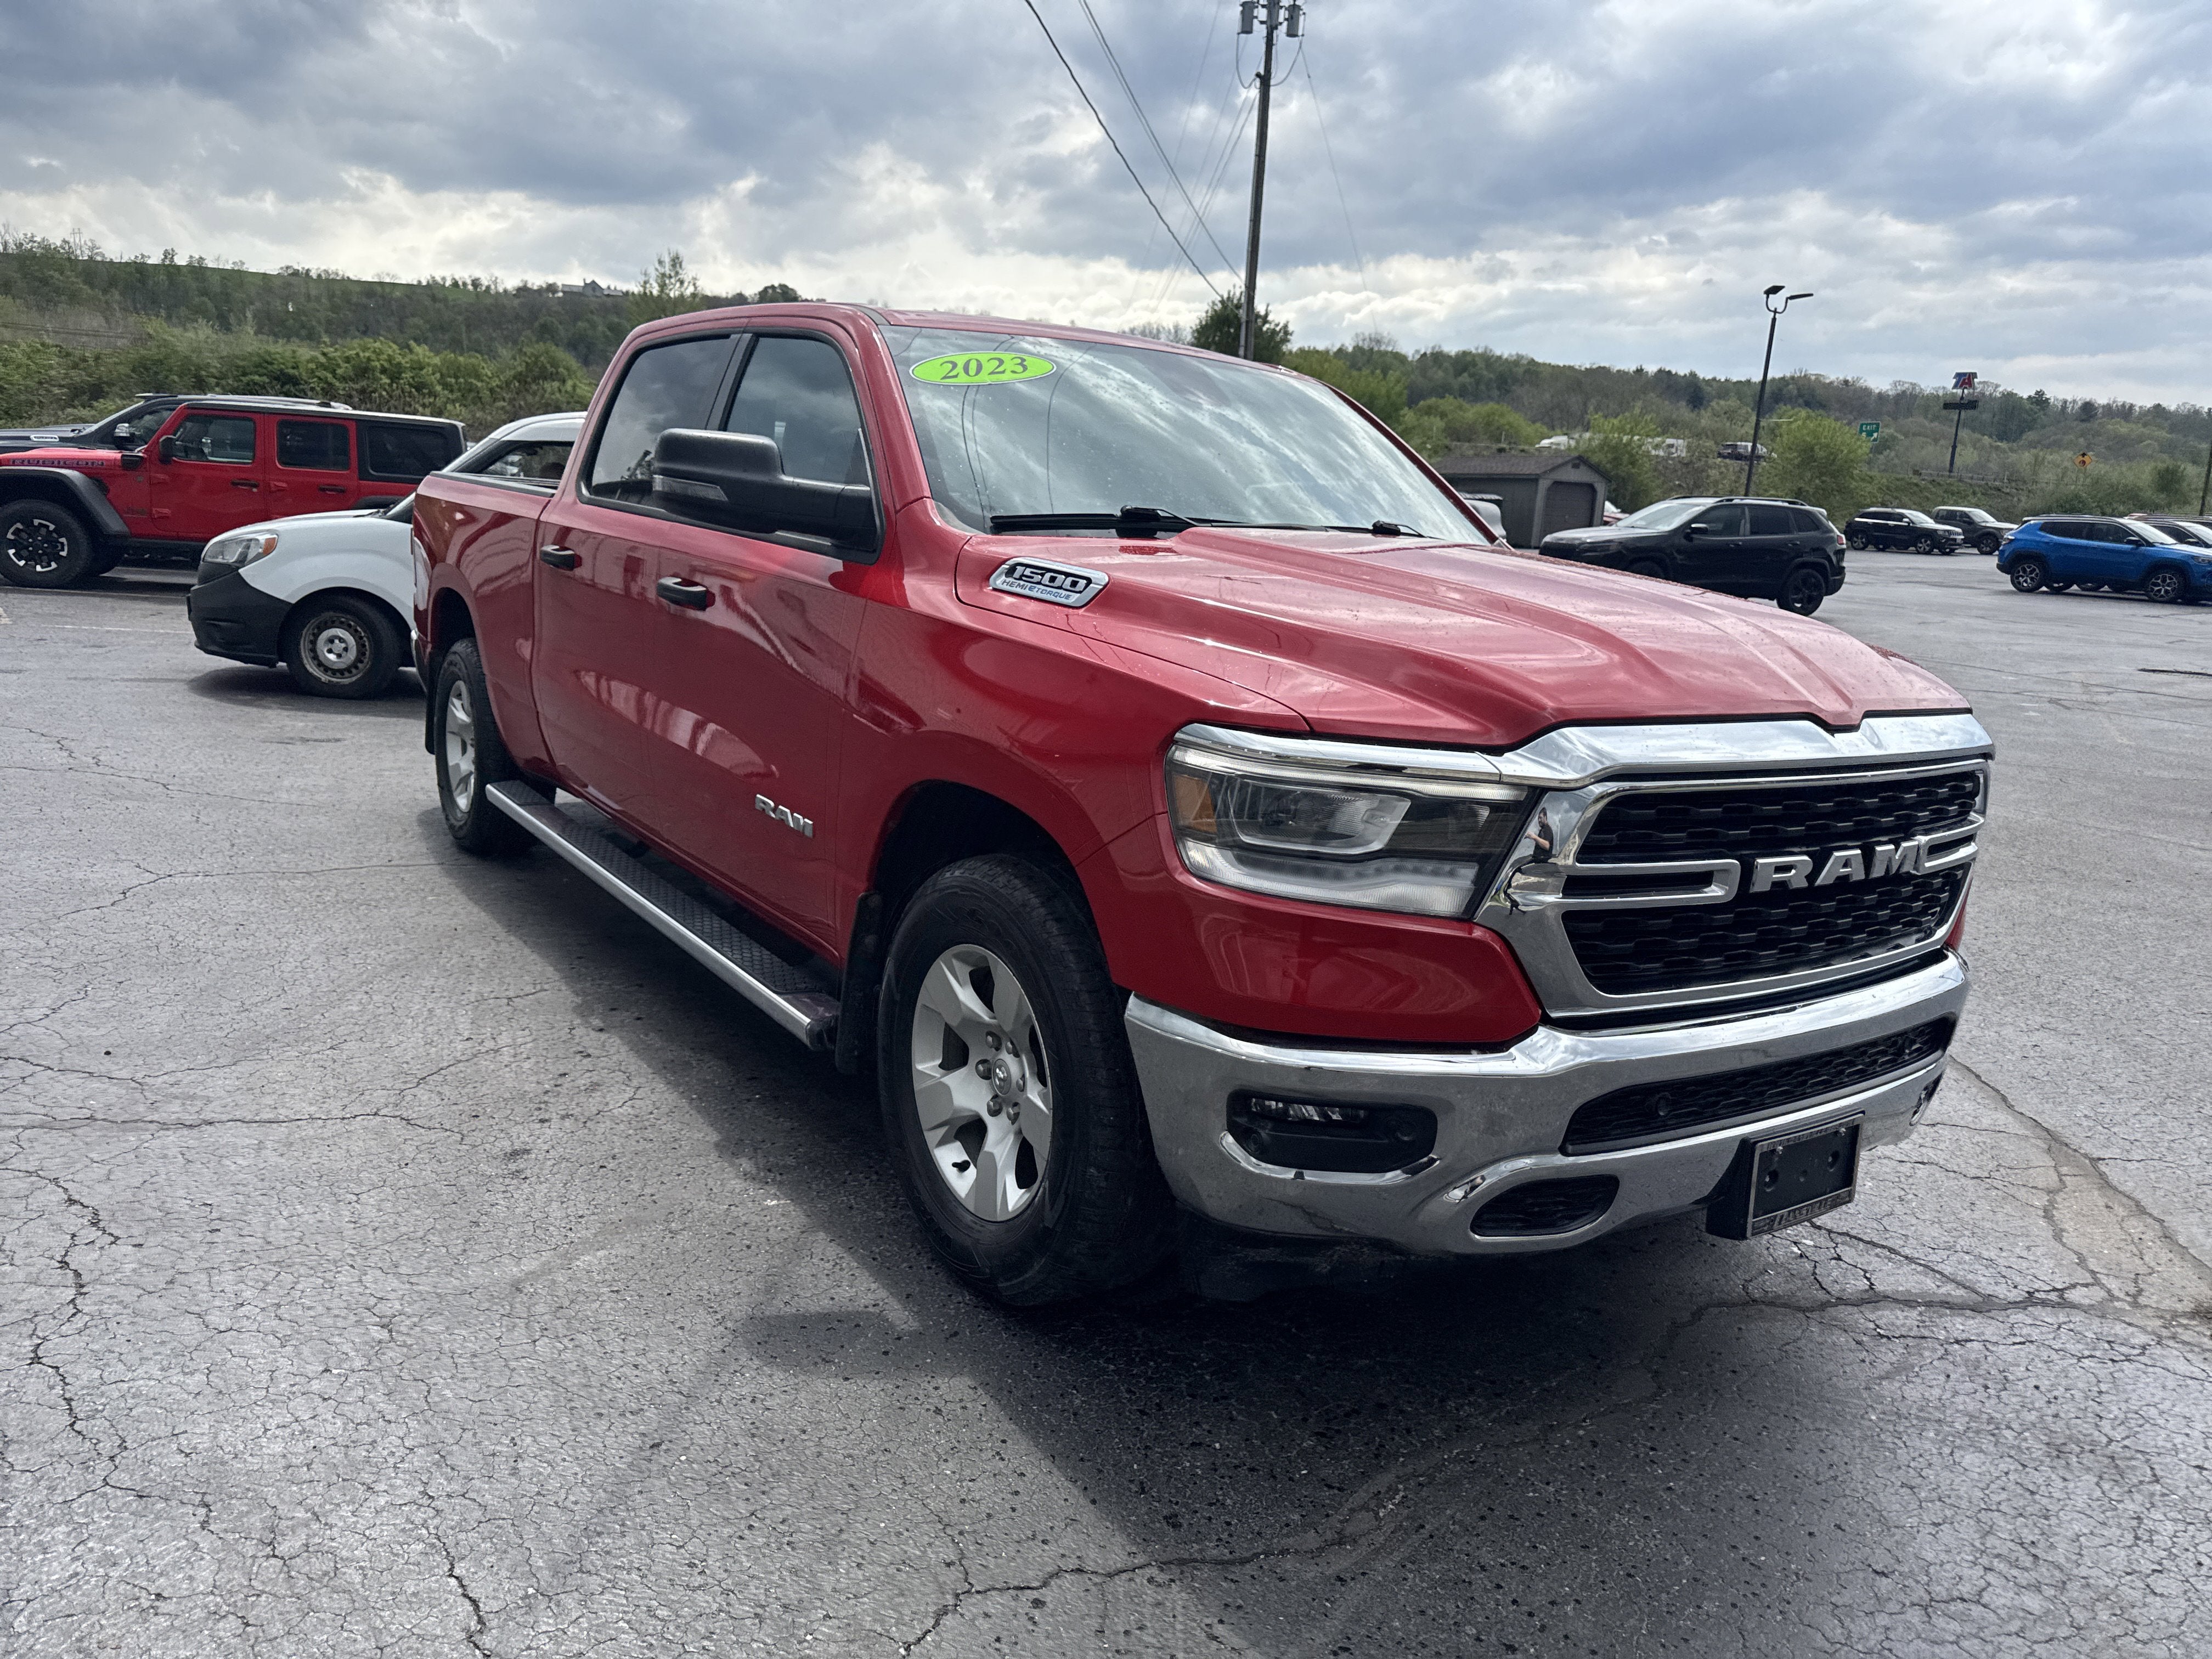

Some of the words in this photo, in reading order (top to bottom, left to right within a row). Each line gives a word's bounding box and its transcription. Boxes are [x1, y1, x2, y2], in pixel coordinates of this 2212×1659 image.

[940, 357, 1028, 380] 2023
[1952, 372, 1978, 390] TA
[1001, 579, 1029, 590] HEMI
[1013, 566, 1087, 592] 1500
[755, 794, 814, 838] RAM
[1750, 840, 1919, 893] RAM
